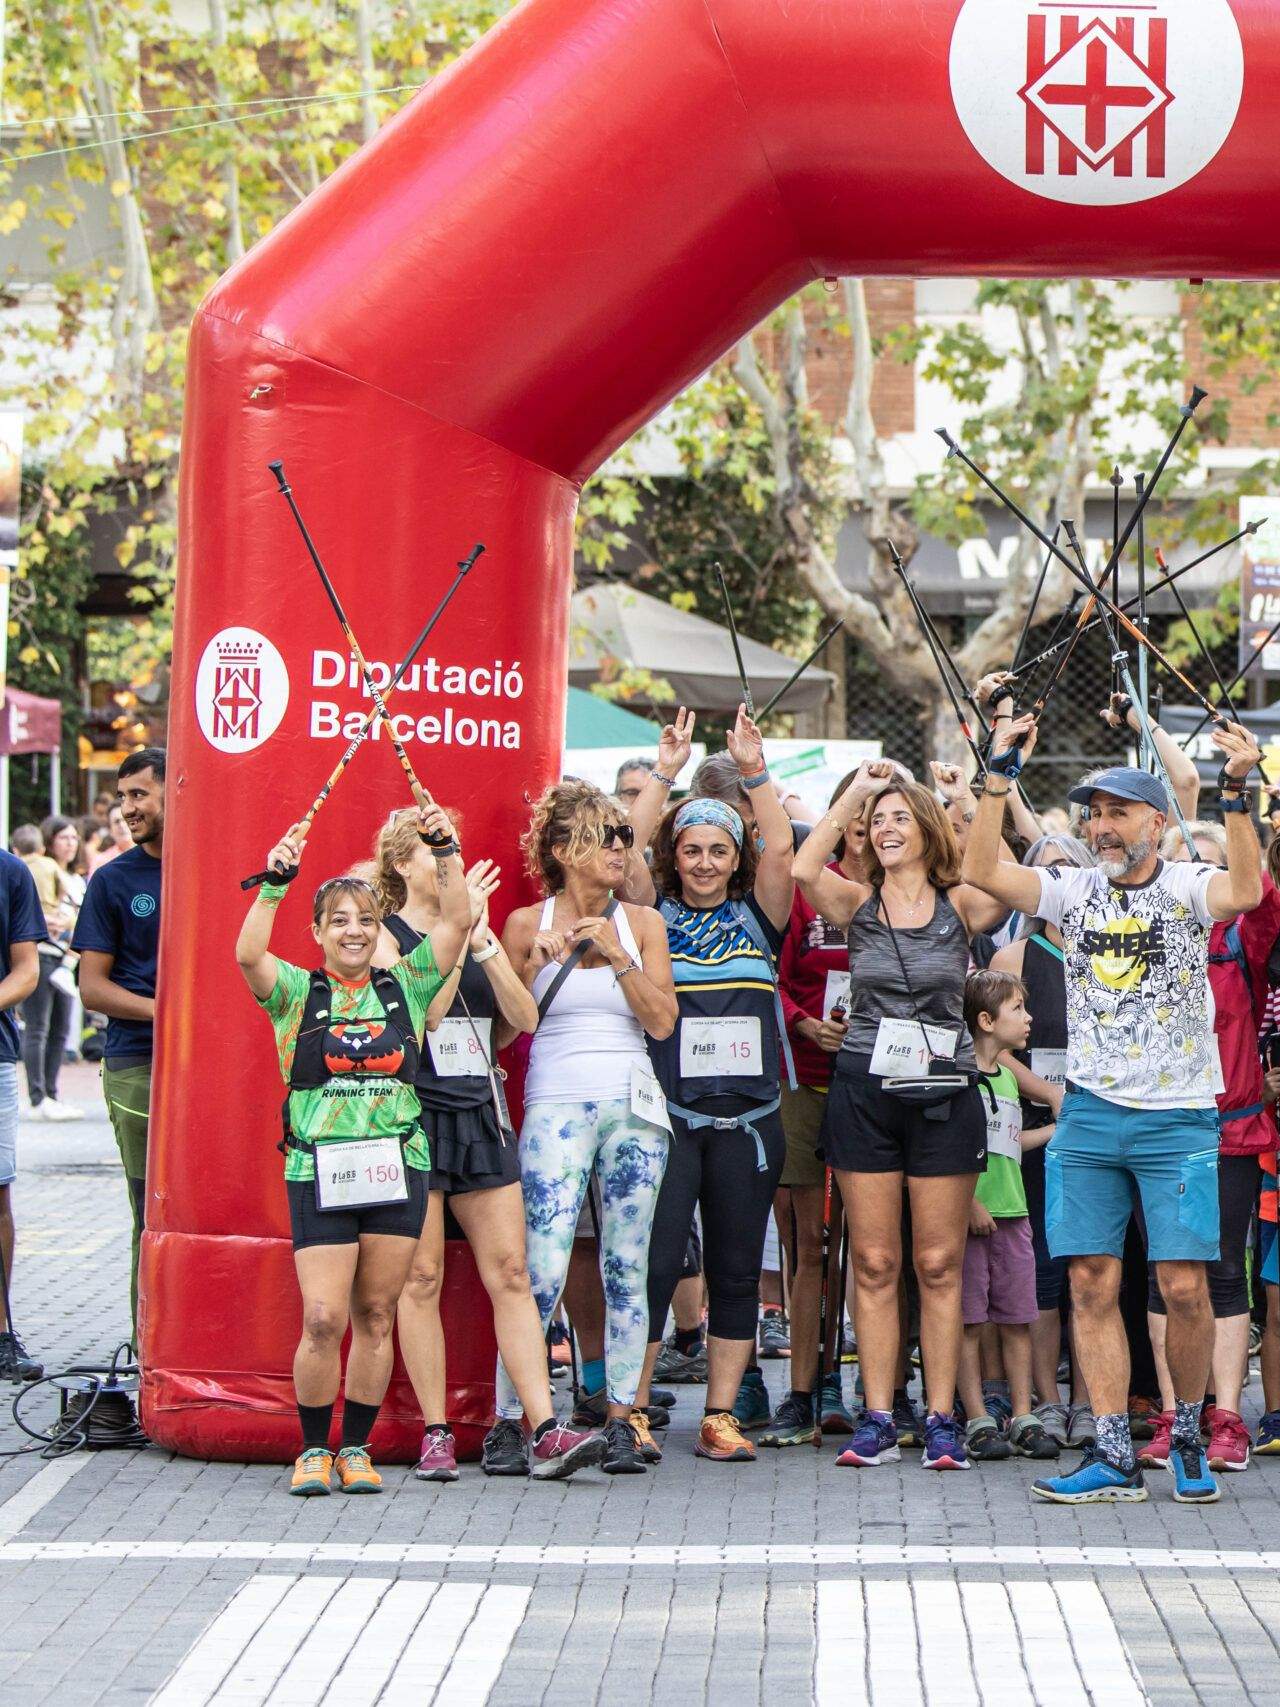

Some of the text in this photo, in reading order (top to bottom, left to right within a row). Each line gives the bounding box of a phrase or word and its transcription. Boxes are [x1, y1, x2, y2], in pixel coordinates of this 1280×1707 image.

[312, 649, 524, 699] Diputació
[309, 700, 521, 750] Barcelona
[729, 1041, 751, 1058] 15
[368, 1087, 394, 1097] TEAM
[364, 1163, 399, 1183] 150
